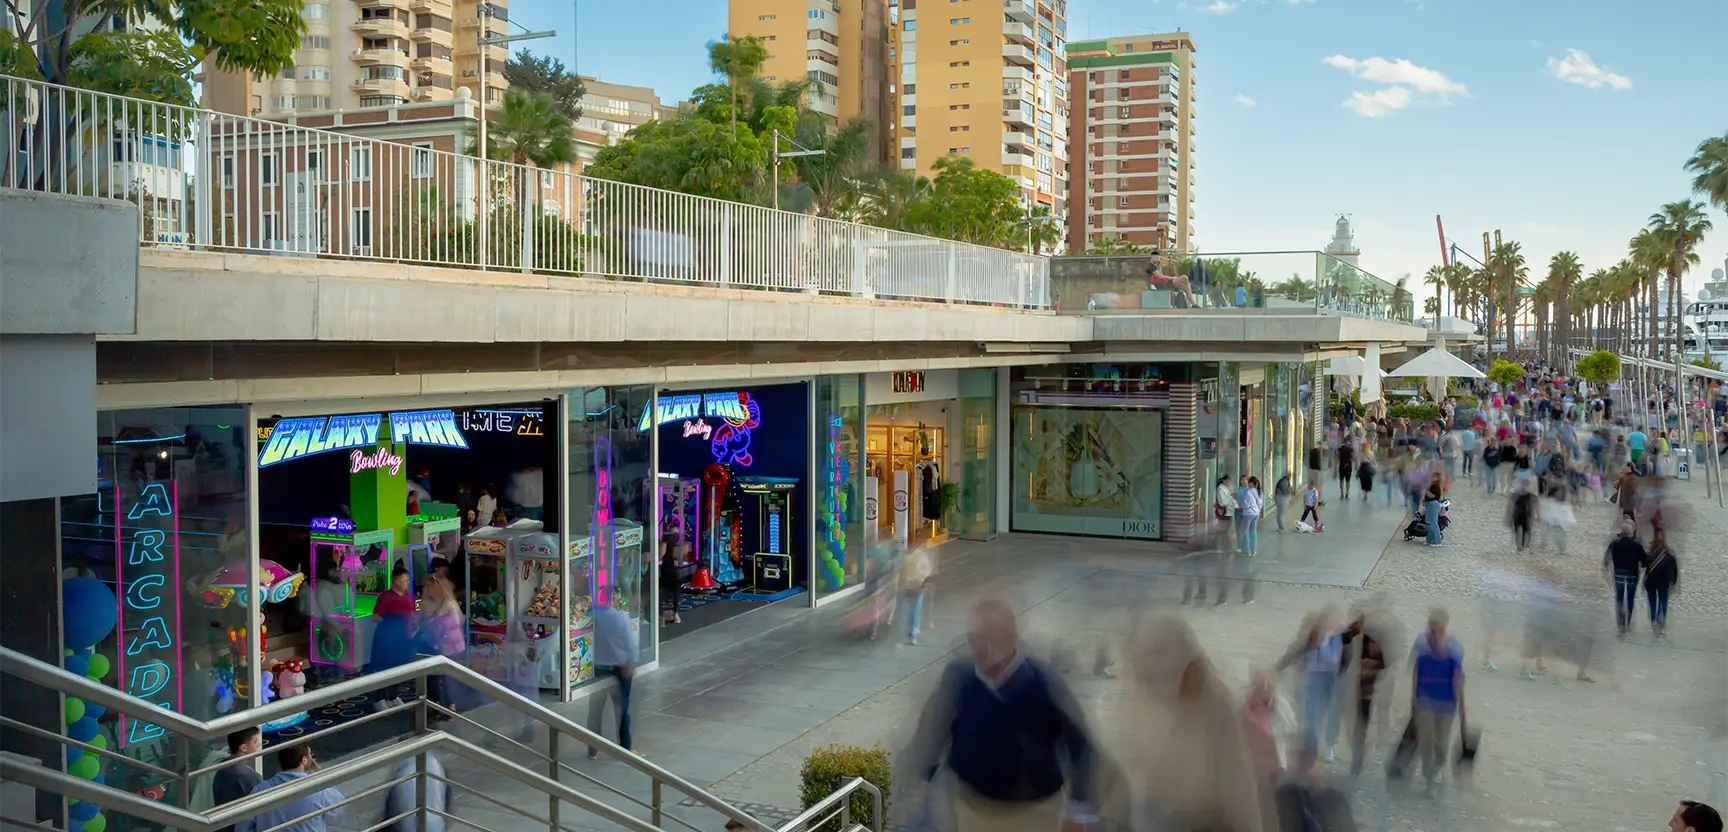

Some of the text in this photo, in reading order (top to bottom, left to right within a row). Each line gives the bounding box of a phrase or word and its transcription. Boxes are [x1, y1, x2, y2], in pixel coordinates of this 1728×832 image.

[704, 392, 746, 420] PARK
[257, 414, 383, 468] GALAXY
[388, 409, 469, 449] PARK
[684, 418, 712, 440] Bowling
[350, 446, 403, 476] Bowling
[328, 516, 338, 530] 2
[1121, 521, 1156, 534] DIOR
[597, 469, 609, 607] BOWLING
